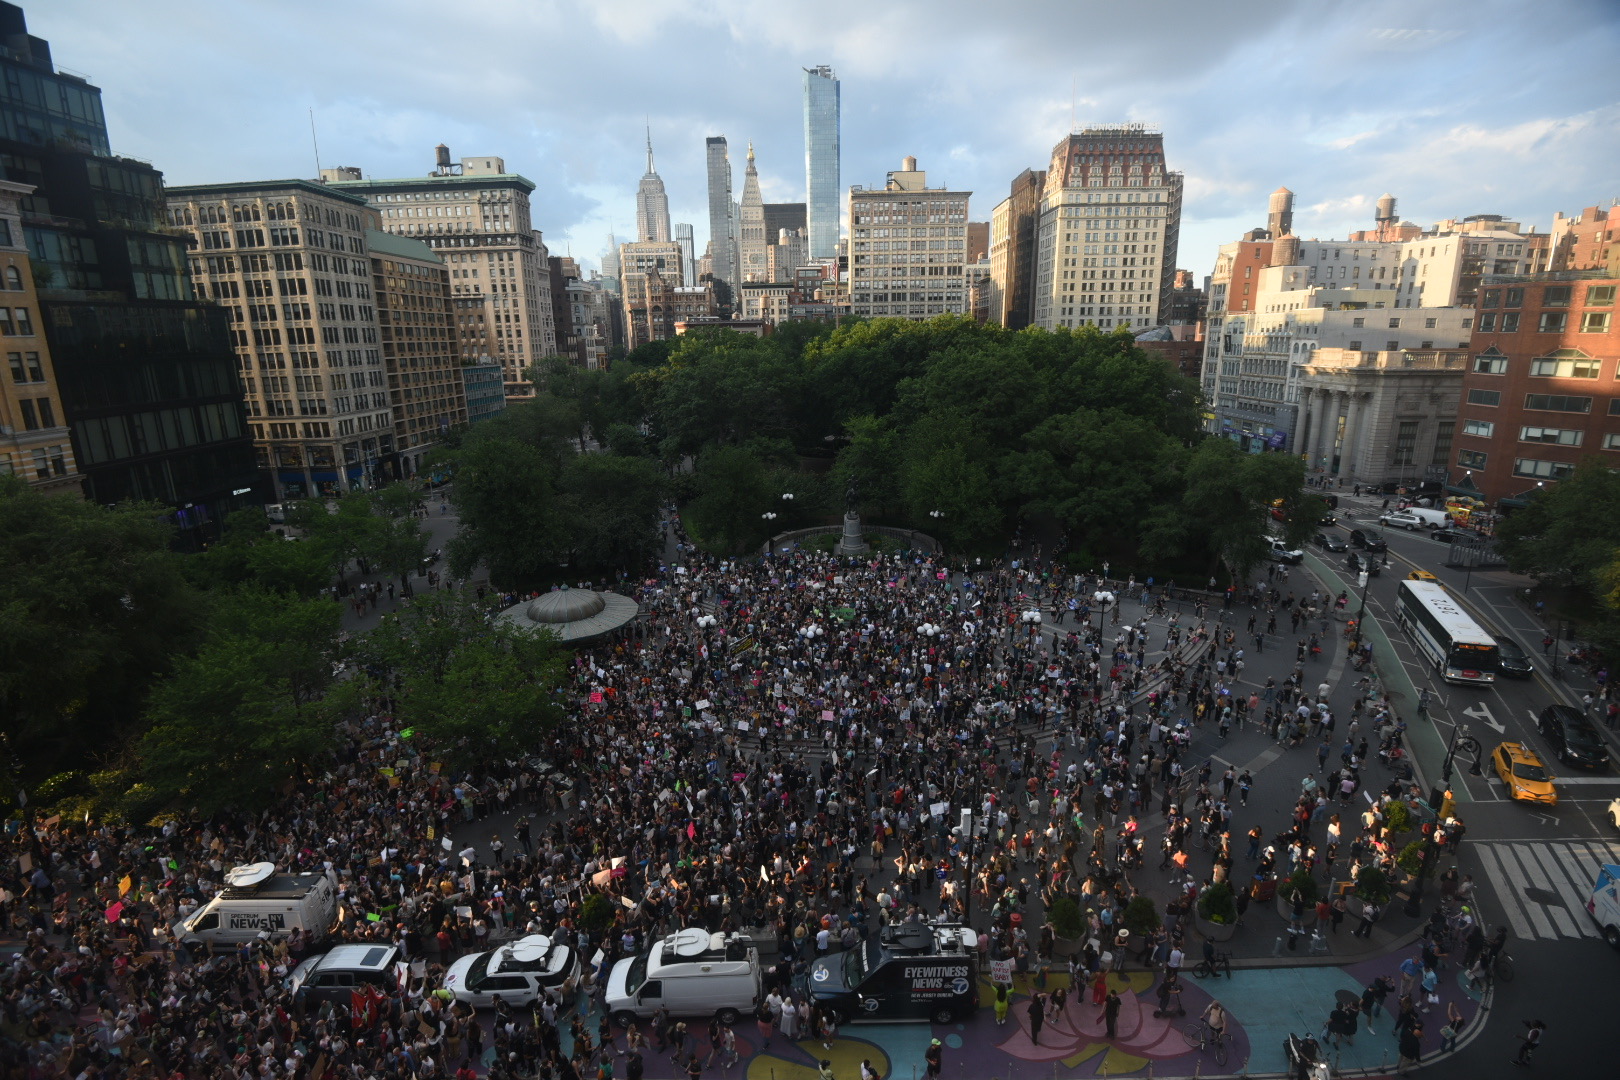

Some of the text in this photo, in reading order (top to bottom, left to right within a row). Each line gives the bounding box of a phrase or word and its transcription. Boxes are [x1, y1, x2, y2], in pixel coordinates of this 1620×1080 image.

[1091, 122, 1122, 131] UNION
[230, 919, 267, 929] NEWS
[904, 966, 969, 978] EYEWITNESS
[912, 978, 944, 989] NEWS
[952, 978, 969, 994] 7
[865, 998, 878, 1011] 7
